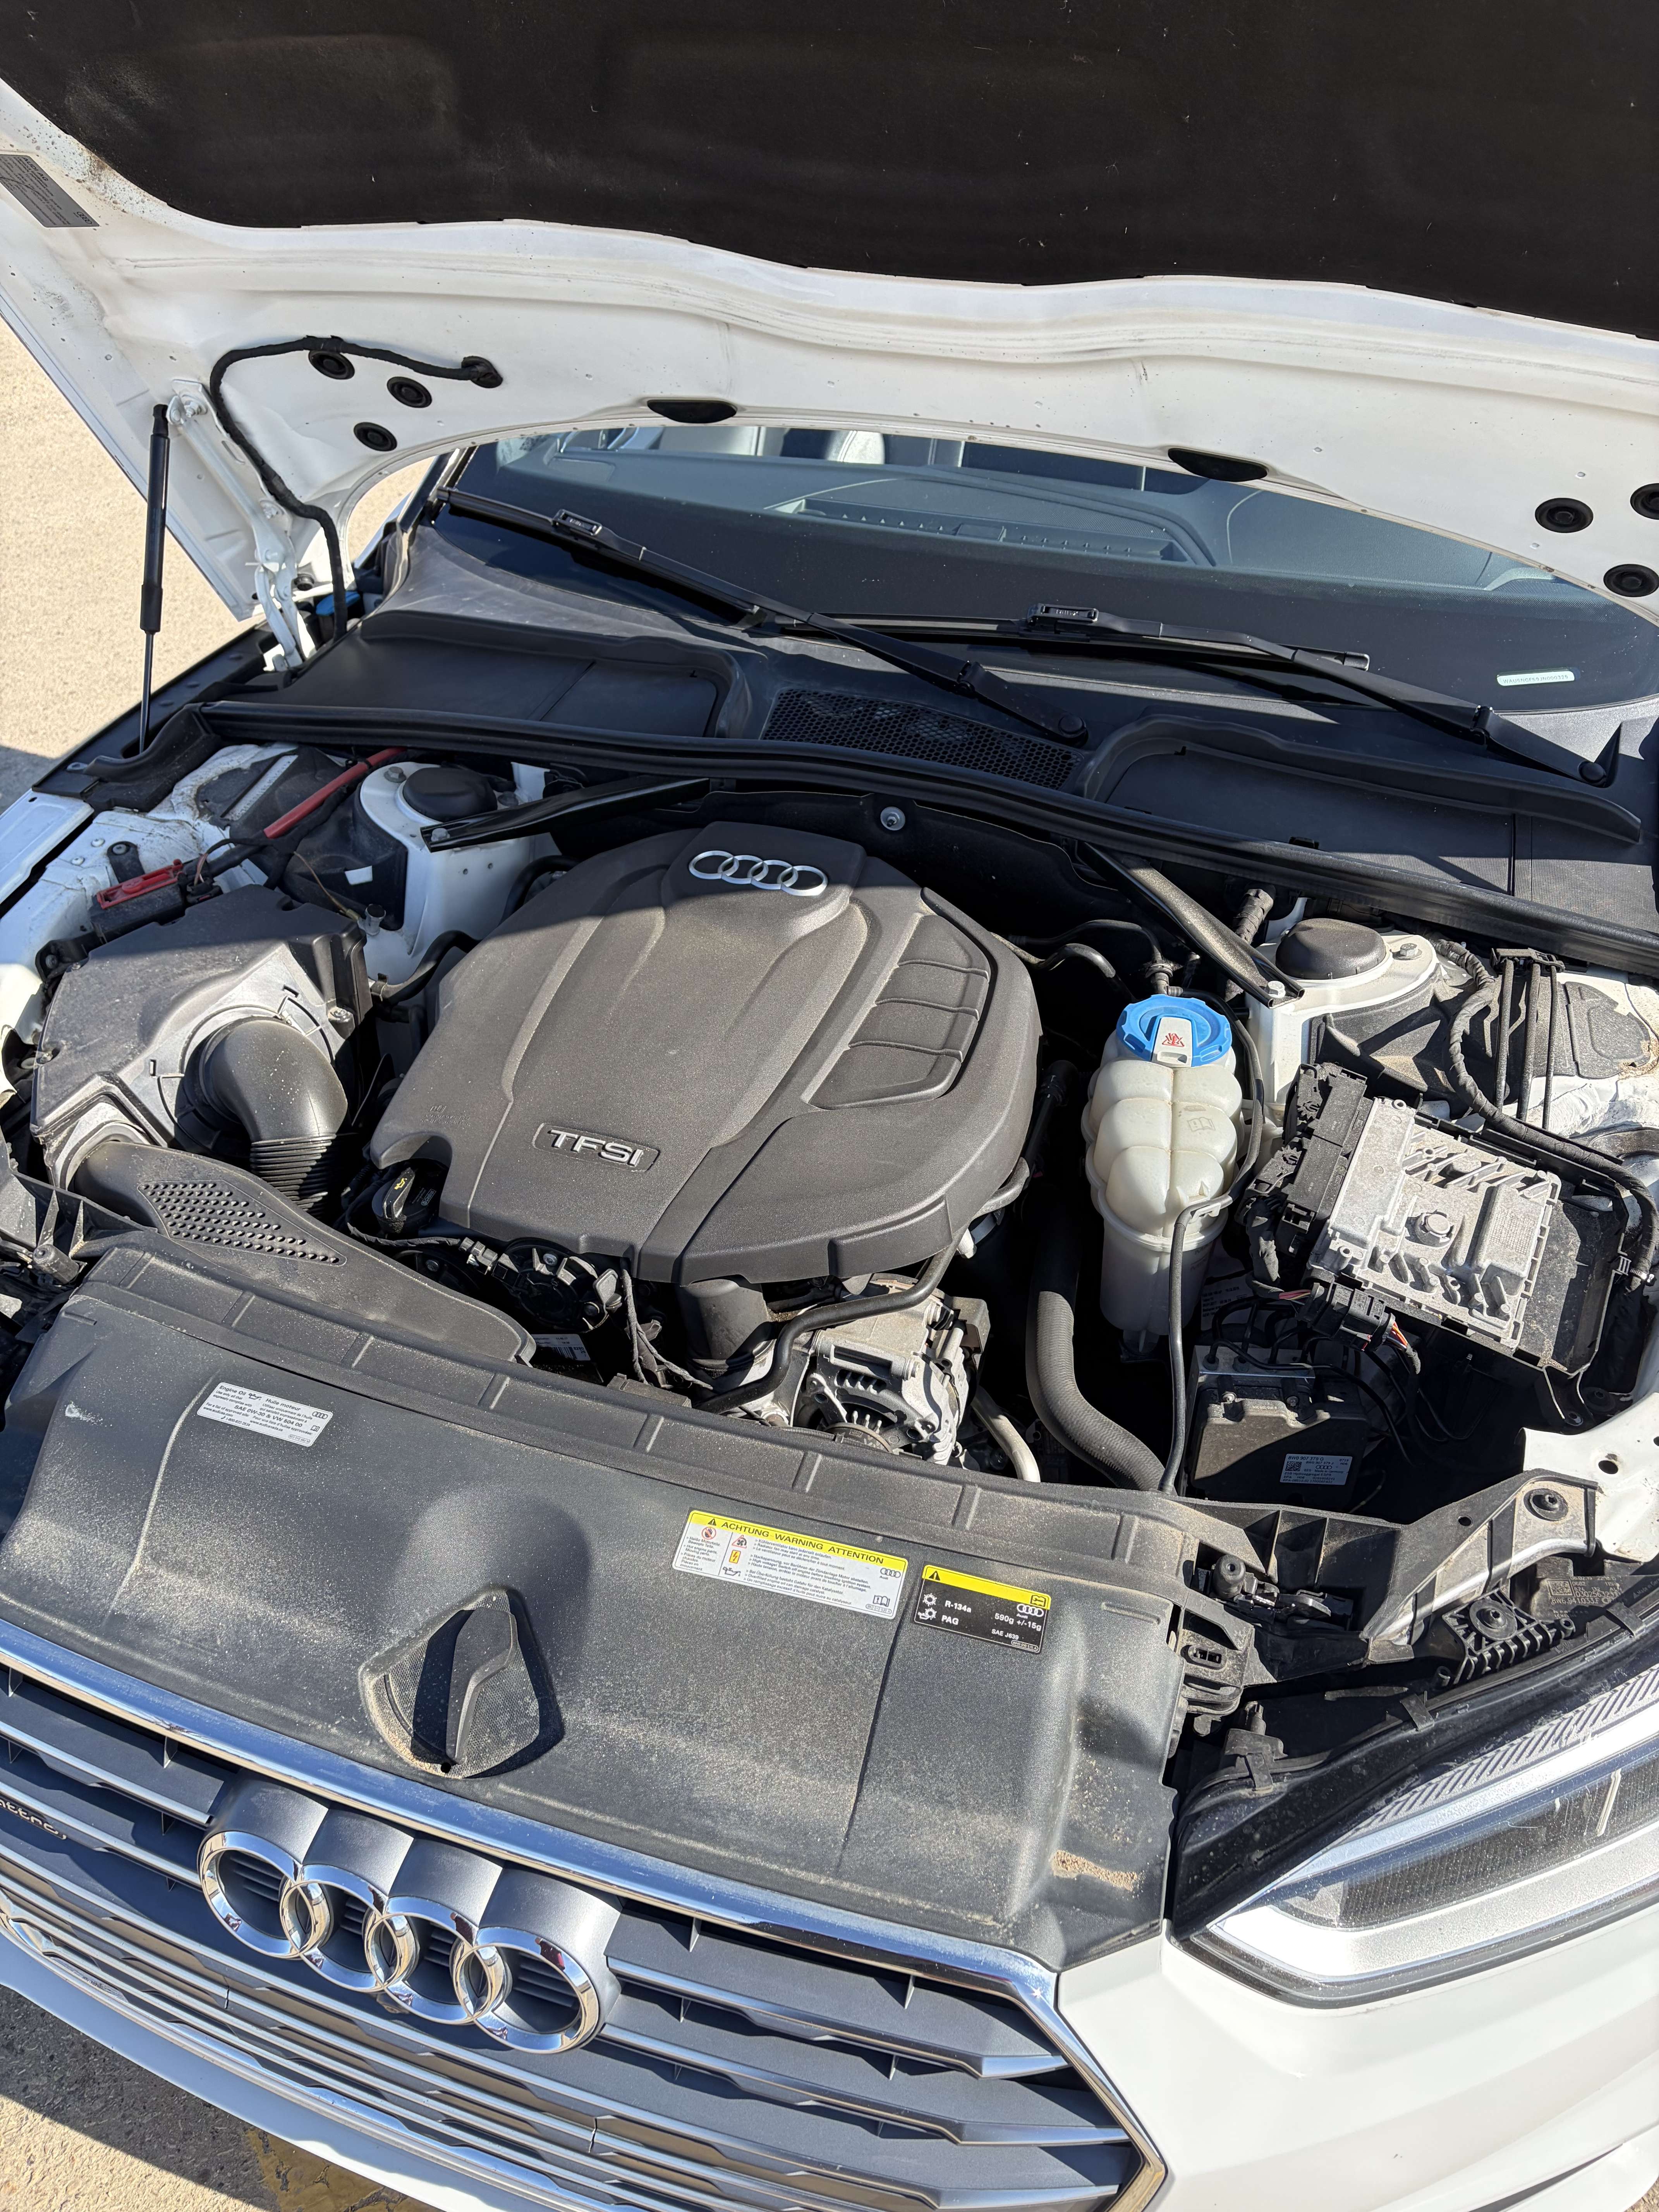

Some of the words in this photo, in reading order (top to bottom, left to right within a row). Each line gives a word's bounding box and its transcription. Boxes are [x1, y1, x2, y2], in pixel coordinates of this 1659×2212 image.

[22, 158, 39, 170] AUDI
[37, 172, 48, 181] AG
[549, 1129, 644, 1166] TFSI
[247, 1408, 265, 1417] 0W-30
[721, 1522, 769, 1537] ACHTUNG
[775, 1533, 823, 1549] WARNING
[828, 1546, 883, 1564] ATTENTION
[945, 1600, 971, 1613] R-134a
[941, 1615, 959, 1625] PAG
[994, 1613, 1014, 1625] 590g
[1017, 1620, 1041, 1632] +/-15g
